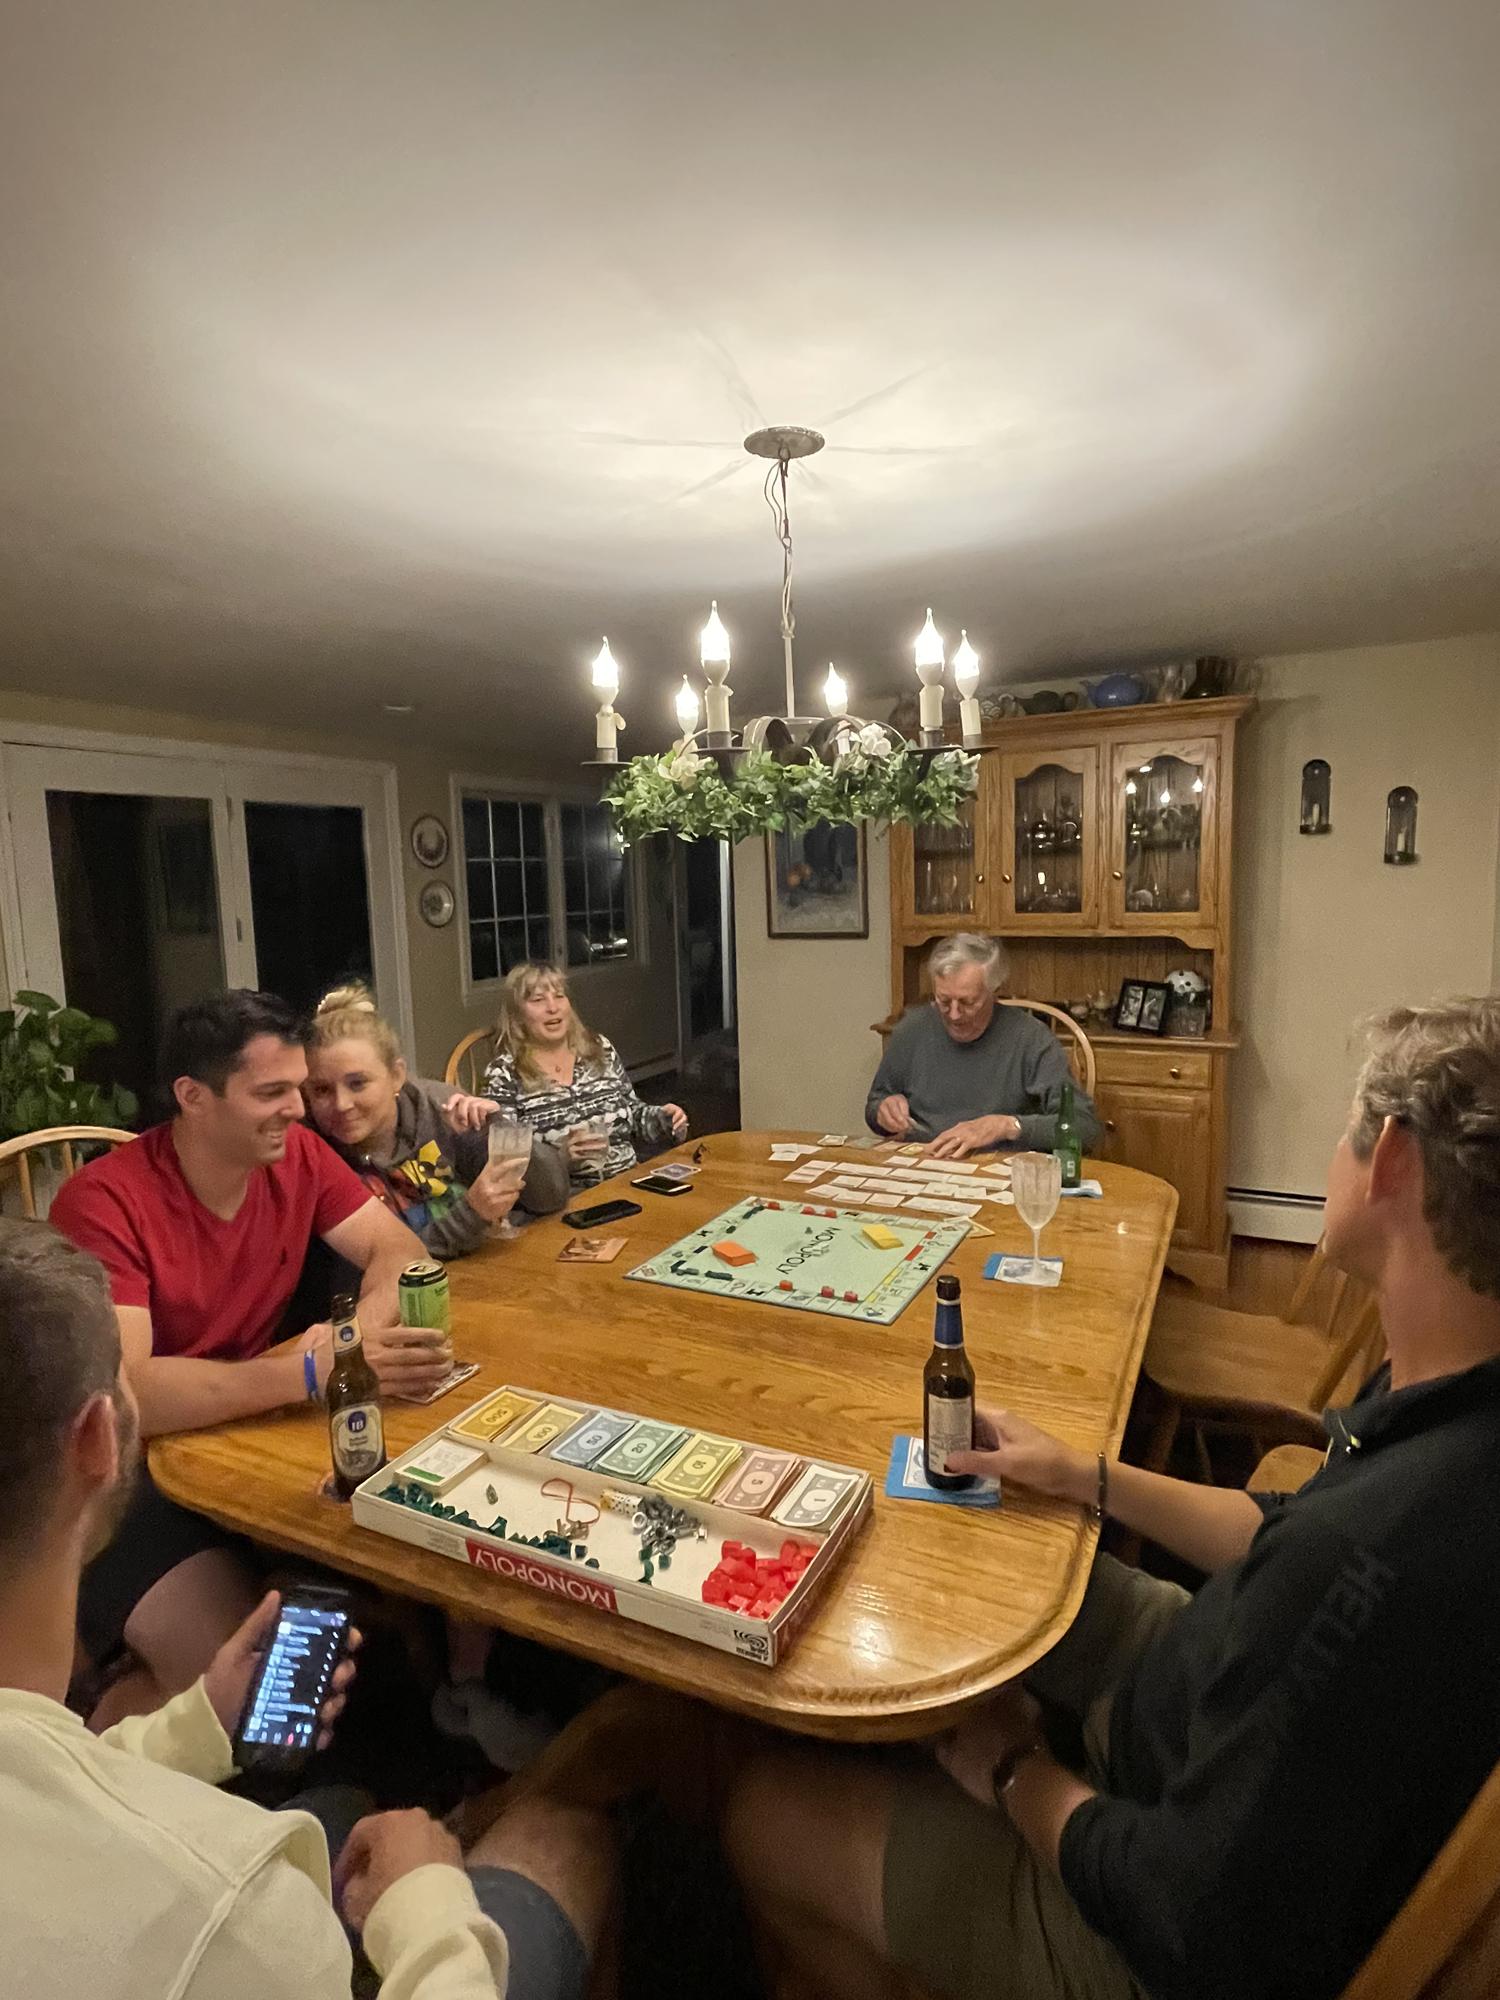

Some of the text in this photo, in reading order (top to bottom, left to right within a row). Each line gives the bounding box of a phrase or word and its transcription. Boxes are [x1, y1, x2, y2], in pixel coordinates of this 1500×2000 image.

[485, 1408, 509, 1425] 500
[532, 1426, 553, 1441] 100
[586, 1434, 603, 1447] 50
[631, 1442, 648, 1455] 20
[692, 1459, 707, 1471] 10
[751, 1478, 764, 1486] 5
[475, 1549, 612, 1609] MONOPOLY
